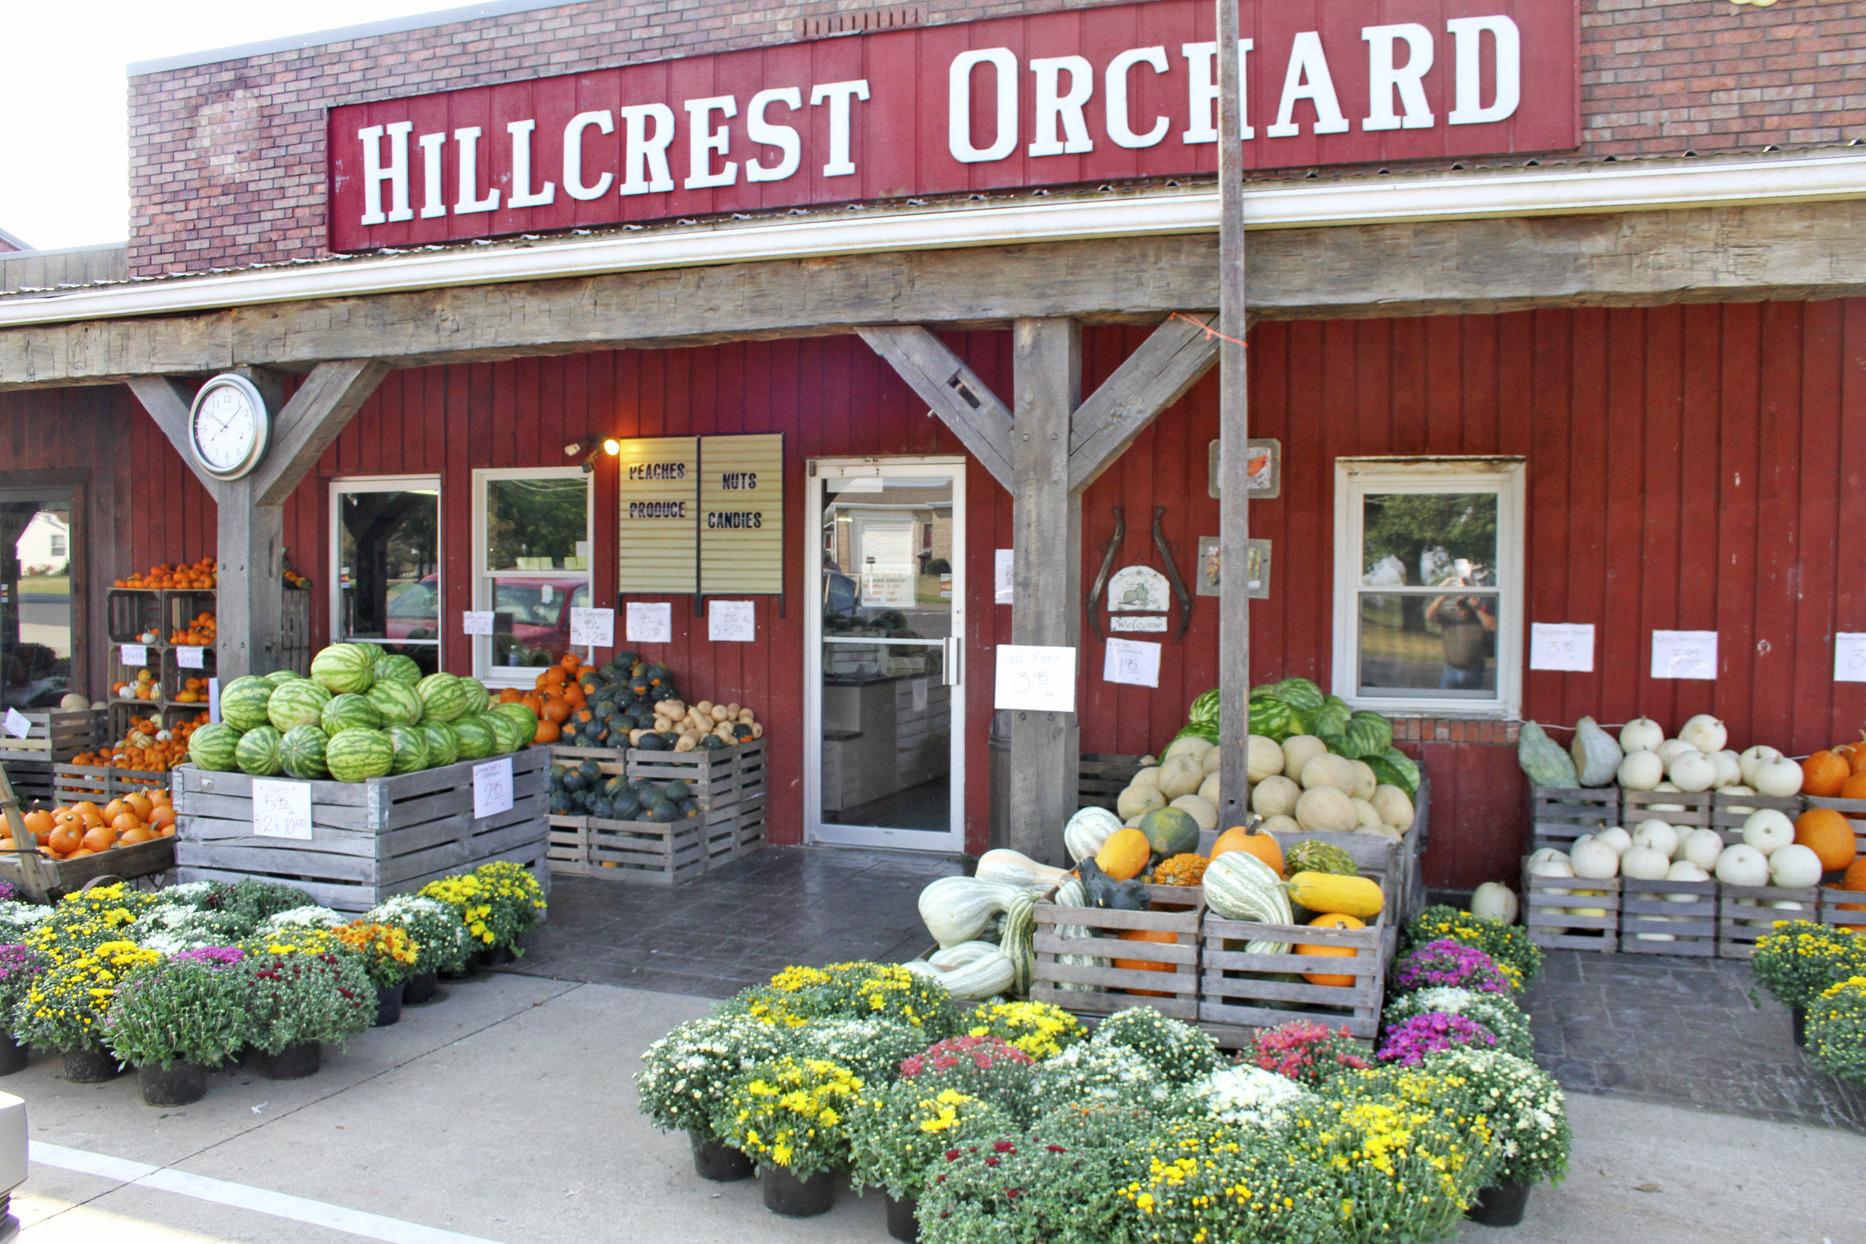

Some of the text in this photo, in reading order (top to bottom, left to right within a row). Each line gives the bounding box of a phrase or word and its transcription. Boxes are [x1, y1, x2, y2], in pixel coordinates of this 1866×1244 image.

[358, 14, 1520, 226] HILLCREST ORCHARD
[629, 463, 685, 480] PEACHES
[722, 473, 757, 490] NUTS
[629, 502, 686, 518] PRODUCE
[708, 512, 762, 529] CANDIES
[1115, 618, 1163, 630] Welcome
